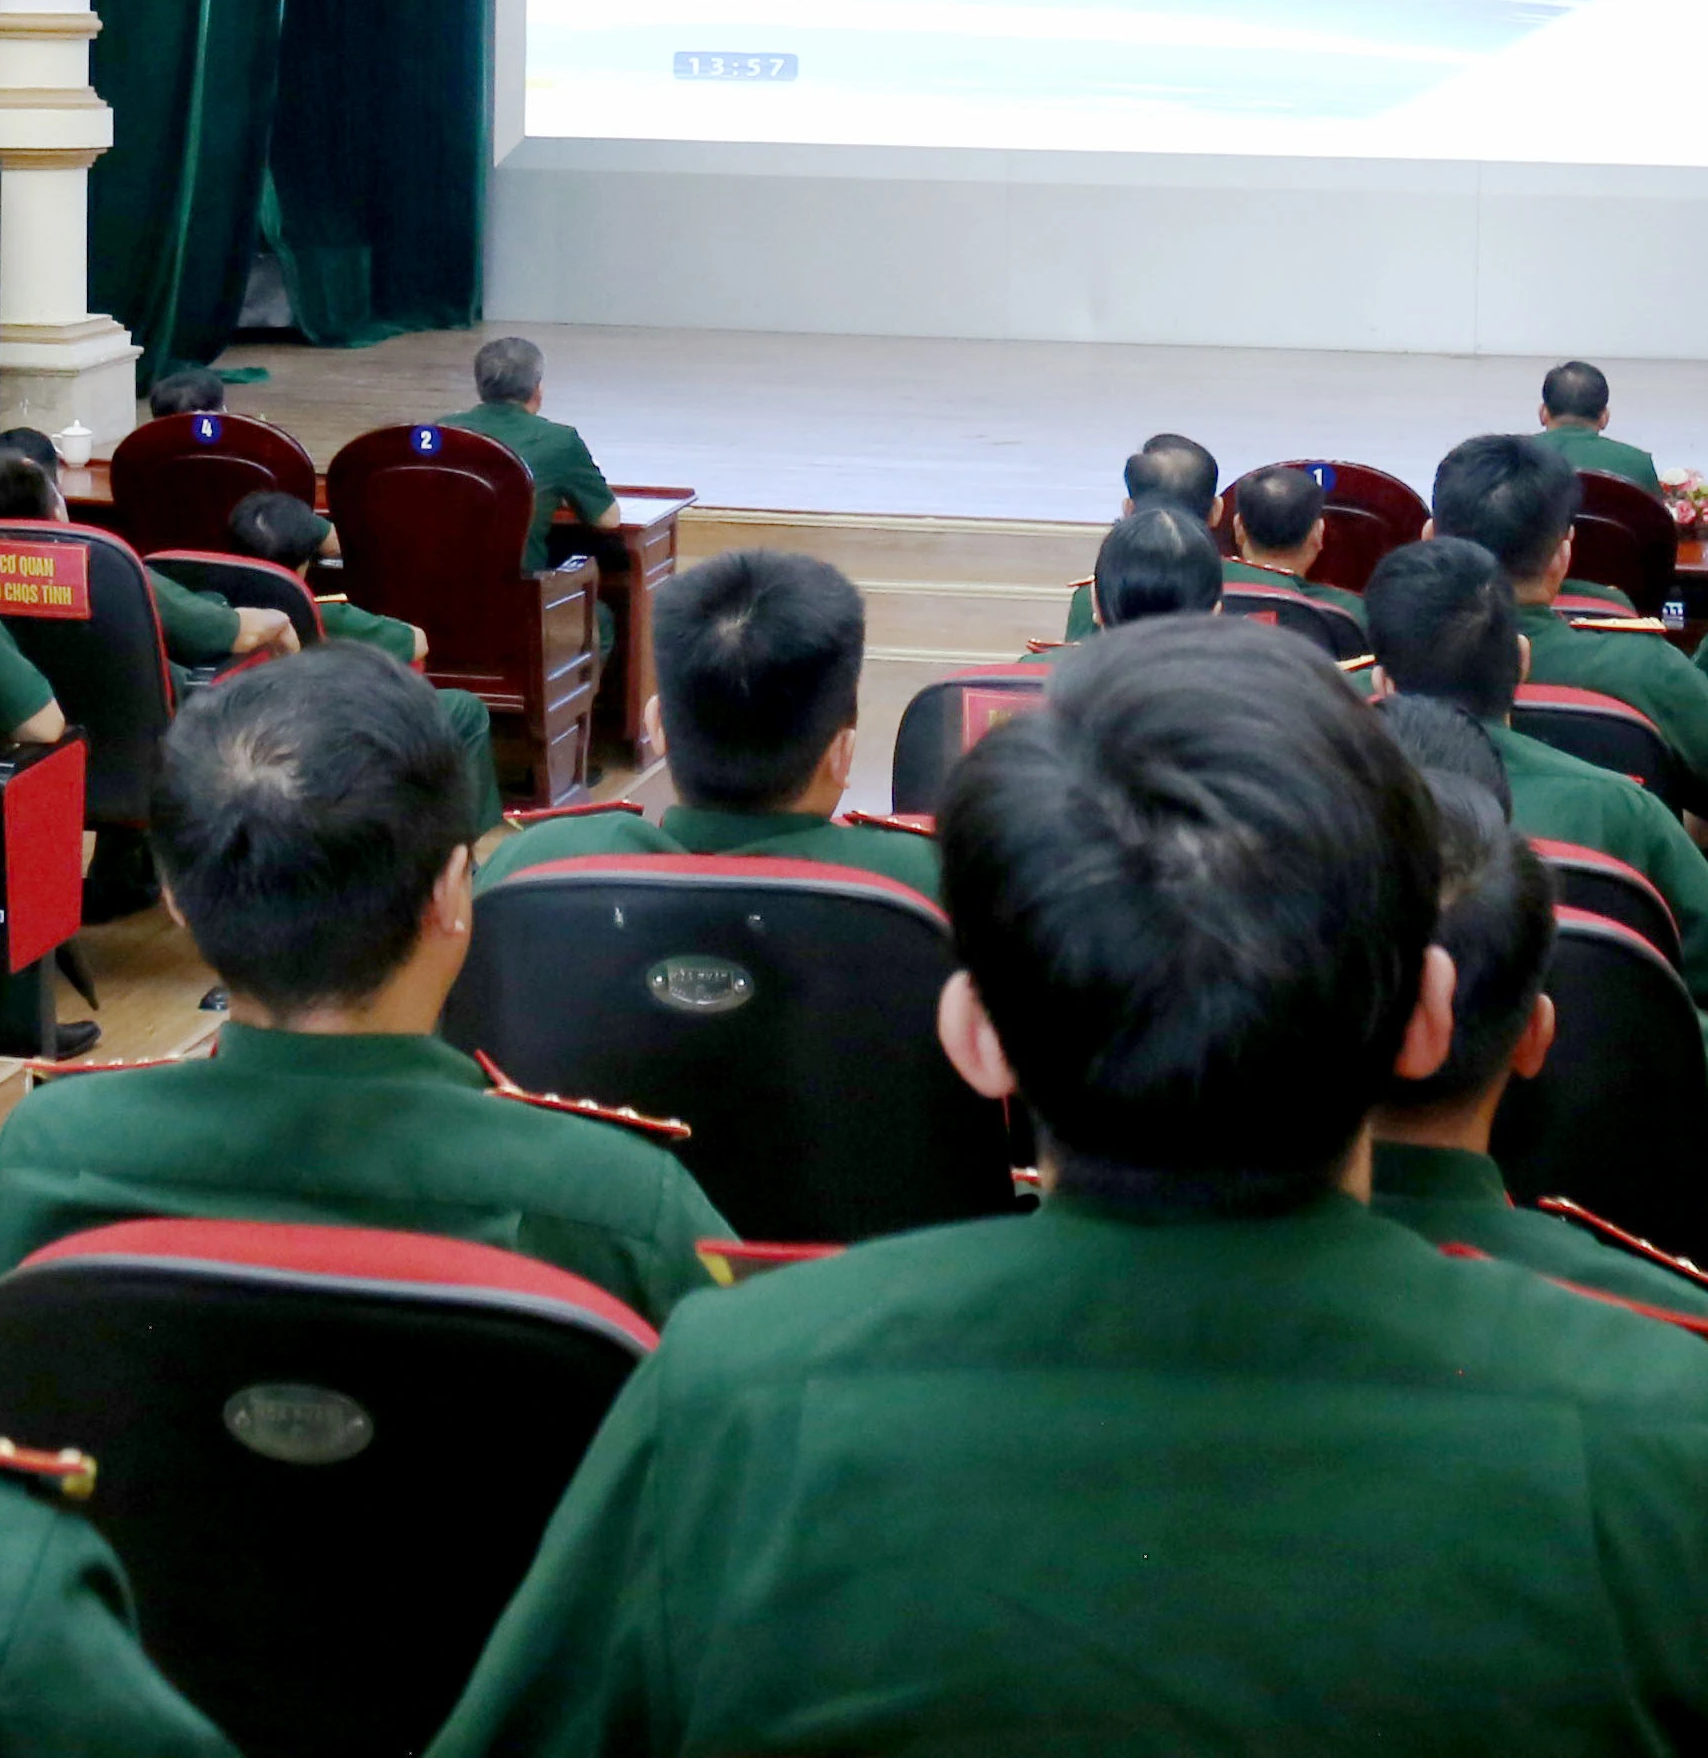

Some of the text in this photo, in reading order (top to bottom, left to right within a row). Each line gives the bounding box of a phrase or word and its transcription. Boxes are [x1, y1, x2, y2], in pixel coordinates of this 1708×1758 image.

[688, 58, 785, 76] 13:57
[201, 418, 213, 437] 4
[420, 431, 431, 448] 2
[1313, 469, 1322, 486] 1
